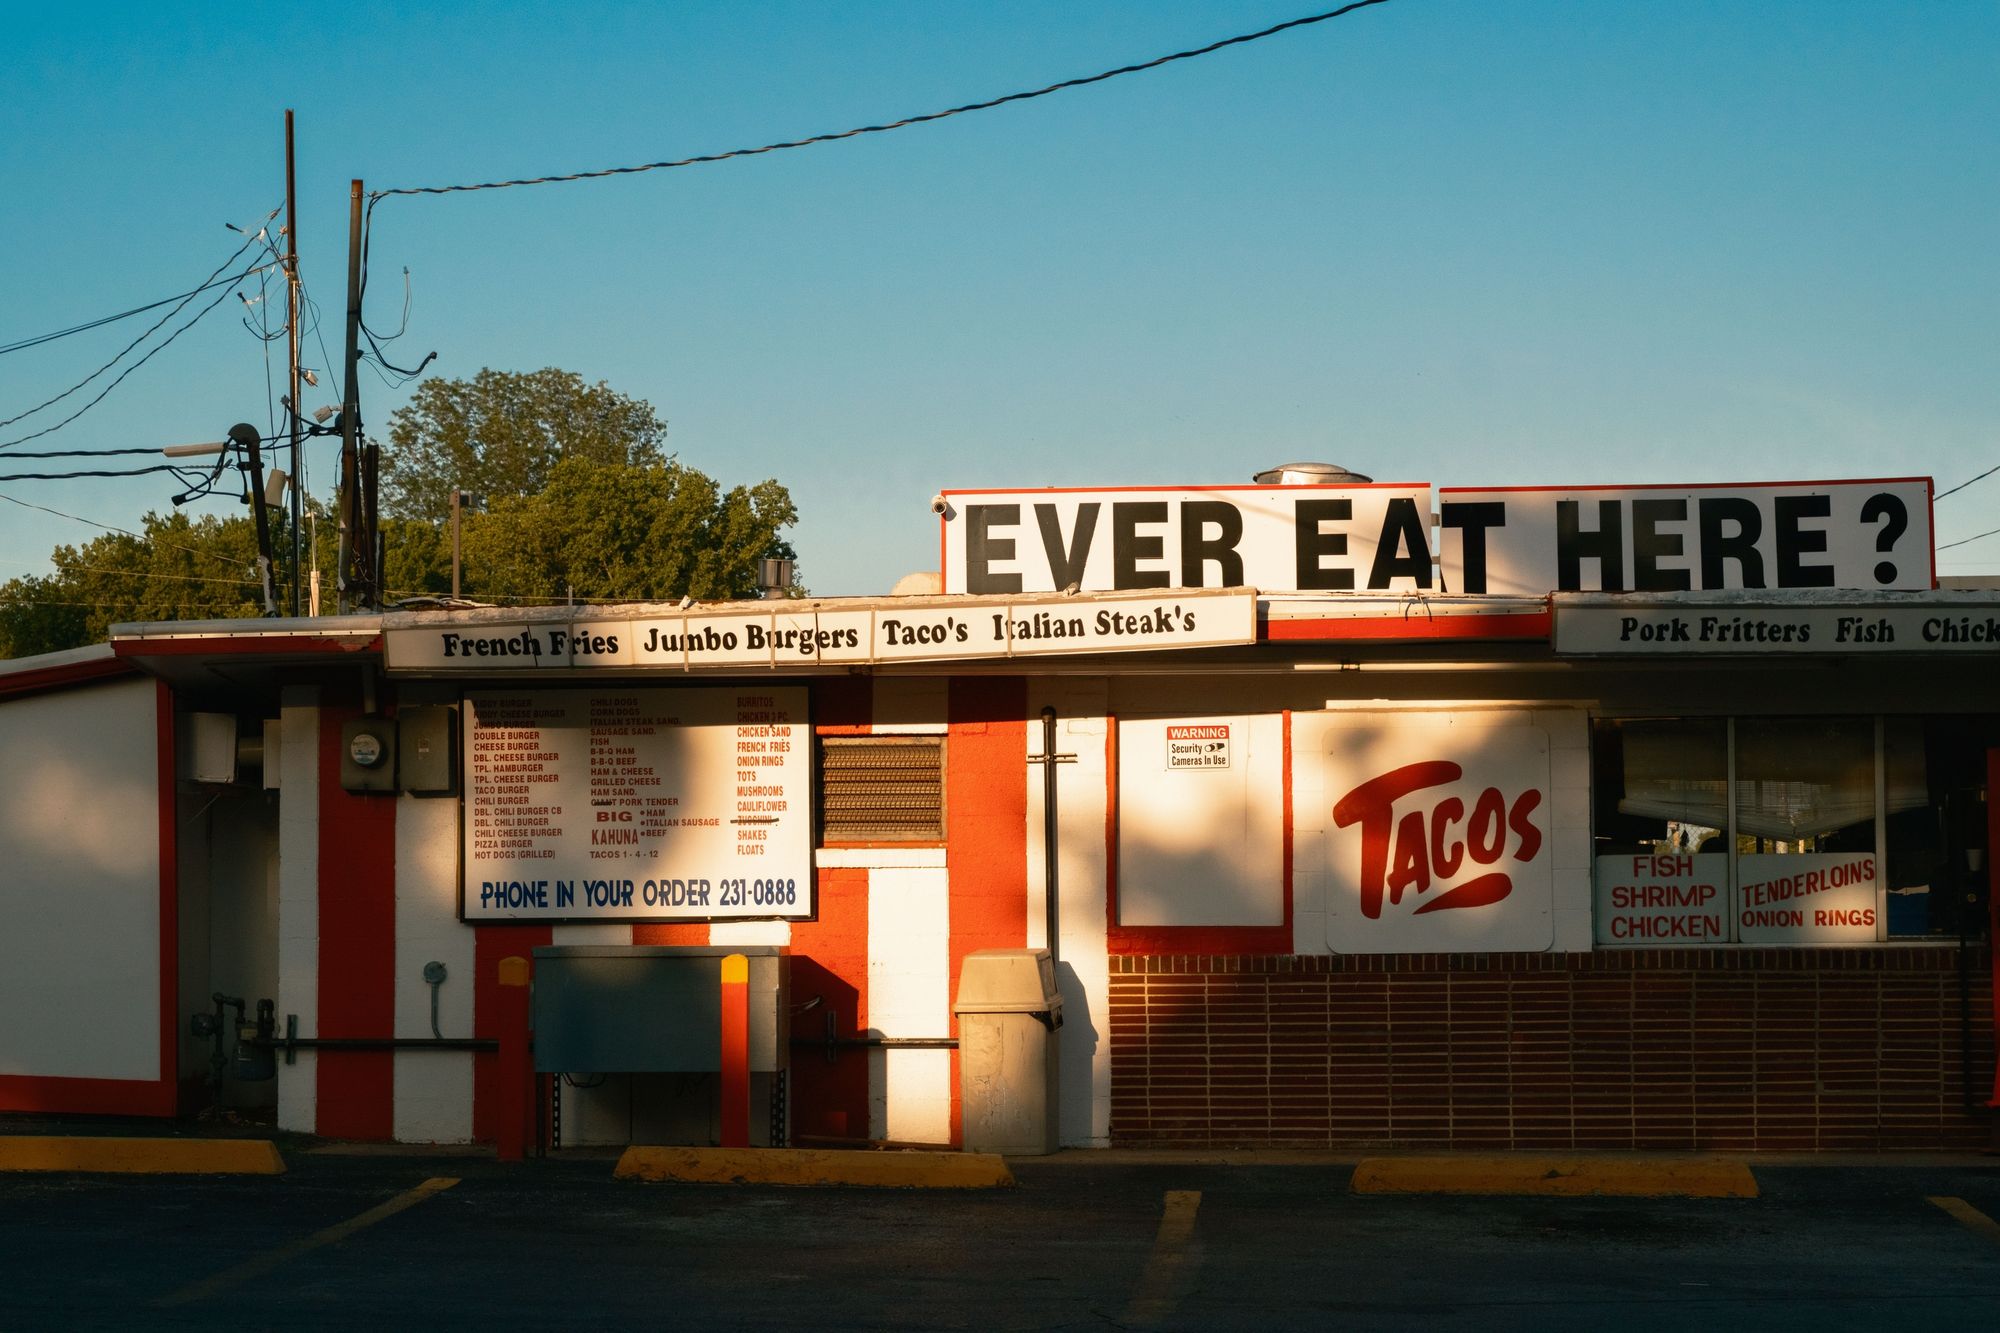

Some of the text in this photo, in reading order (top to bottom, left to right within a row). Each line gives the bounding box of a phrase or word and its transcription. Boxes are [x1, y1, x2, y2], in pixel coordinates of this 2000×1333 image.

[965, 500, 1245, 594] EVER
[1295, 498, 1506, 594] EAT
[993, 605, 1196, 641] Italian Steak's
[882, 617, 969, 645] Taco's
[1620, 617, 1810, 642] Pork Fritters
[1835, 617, 1895, 642] Fish
[1922, 617, 2000, 643] Chick
[442, 630, 619, 657] French Fries
[644, 624, 859, 655] Jumbo Burgers
[590, 698, 639, 707] CHILI DOGS
[737, 697, 773, 708] BURRITOS
[500, 710, 531, 719] CHEESE
[533, 709, 566, 718] BURGER
[590, 708, 640, 717] CORN DOGS
[737, 711, 770, 723] CHICKEN
[474, 720, 536, 729] JUMBO BURGER
[590, 718, 623, 727] ITALIAN
[625, 718, 654, 726] STEAK
[474, 731, 540, 740] DOUBLE BURGER
[590, 727, 657, 736] SAUSAGE SAND.
[737, 727, 791, 738] CHICKEN SAND
[1170, 727, 1227, 739] WARNING
[474, 742, 540, 751] CHEESE BURGER
[590, 738, 610, 746] FISH
[737, 741, 791, 753] FRENCH FRIES
[590, 747, 635, 756] B-B-Q HAM
[1171, 743, 1203, 755] Security
[474, 752, 559, 762] DBL. CHEESE BURGER
[590, 757, 638, 766] B-B-Q BEEF
[737, 756, 784, 767] ONION RINGS
[1171, 754, 1226, 766] Cameras In Use
[474, 764, 544, 773] TPL. HAMBURGER
[590, 767, 654, 776] HAM & CHEESE
[474, 774, 559, 784] TPL. CHEESE BURGER
[737, 770, 757, 782] TOTS
[590, 777, 662, 786] GRILLED CHEESE
[474, 786, 530, 795] TACO BURGER
[590, 788, 637, 797] HAM SAND.
[737, 785, 784, 797] MUSHROOMS
[474, 796, 530, 806] CHILI BURGER
[619, 798, 643, 807] PORK
[645, 798, 679, 806] TENDER
[474, 808, 492, 816] DBL.
[494, 808, 515, 816] CHILI
[517, 807, 549, 815] BURGER
[737, 801, 788, 812] CAULIFLOWER
[597, 812, 632, 822] BIG
[646, 809, 666, 817] HAM
[474, 818, 549, 827] DBL. CHILI BURGER
[646, 818, 720, 827] ITALIAN SAUSAGE
[475, 828, 563, 838] CHILI CHEESE BURGER
[591, 828, 639, 846] KAHUNA
[646, 829, 667, 837] BEEF
[737, 829, 767, 841] SHAKES
[1332, 759, 1542, 919] TACOS
[475, 840, 533, 849] PIZZA BURGER
[475, 851, 491, 859] HOT
[493, 851, 516, 859] DOGS
[589, 851, 620, 859] TACOS
[649, 850, 659, 858] 12
[737, 844, 765, 856] FLOATS
[1632, 855, 1693, 878] FISH
[1741, 859, 1875, 908] TENDERLOINS
[481, 881, 549, 909] PHONE
[555, 880, 574, 908] IN
[583, 879, 634, 908] YOUR
[643, 879, 711, 907] ORDER
[1611, 885, 1716, 909] SHRIMP
[1741, 909, 1875, 928] ONION RINGS
[1611, 915, 1720, 938] CHICKEN
